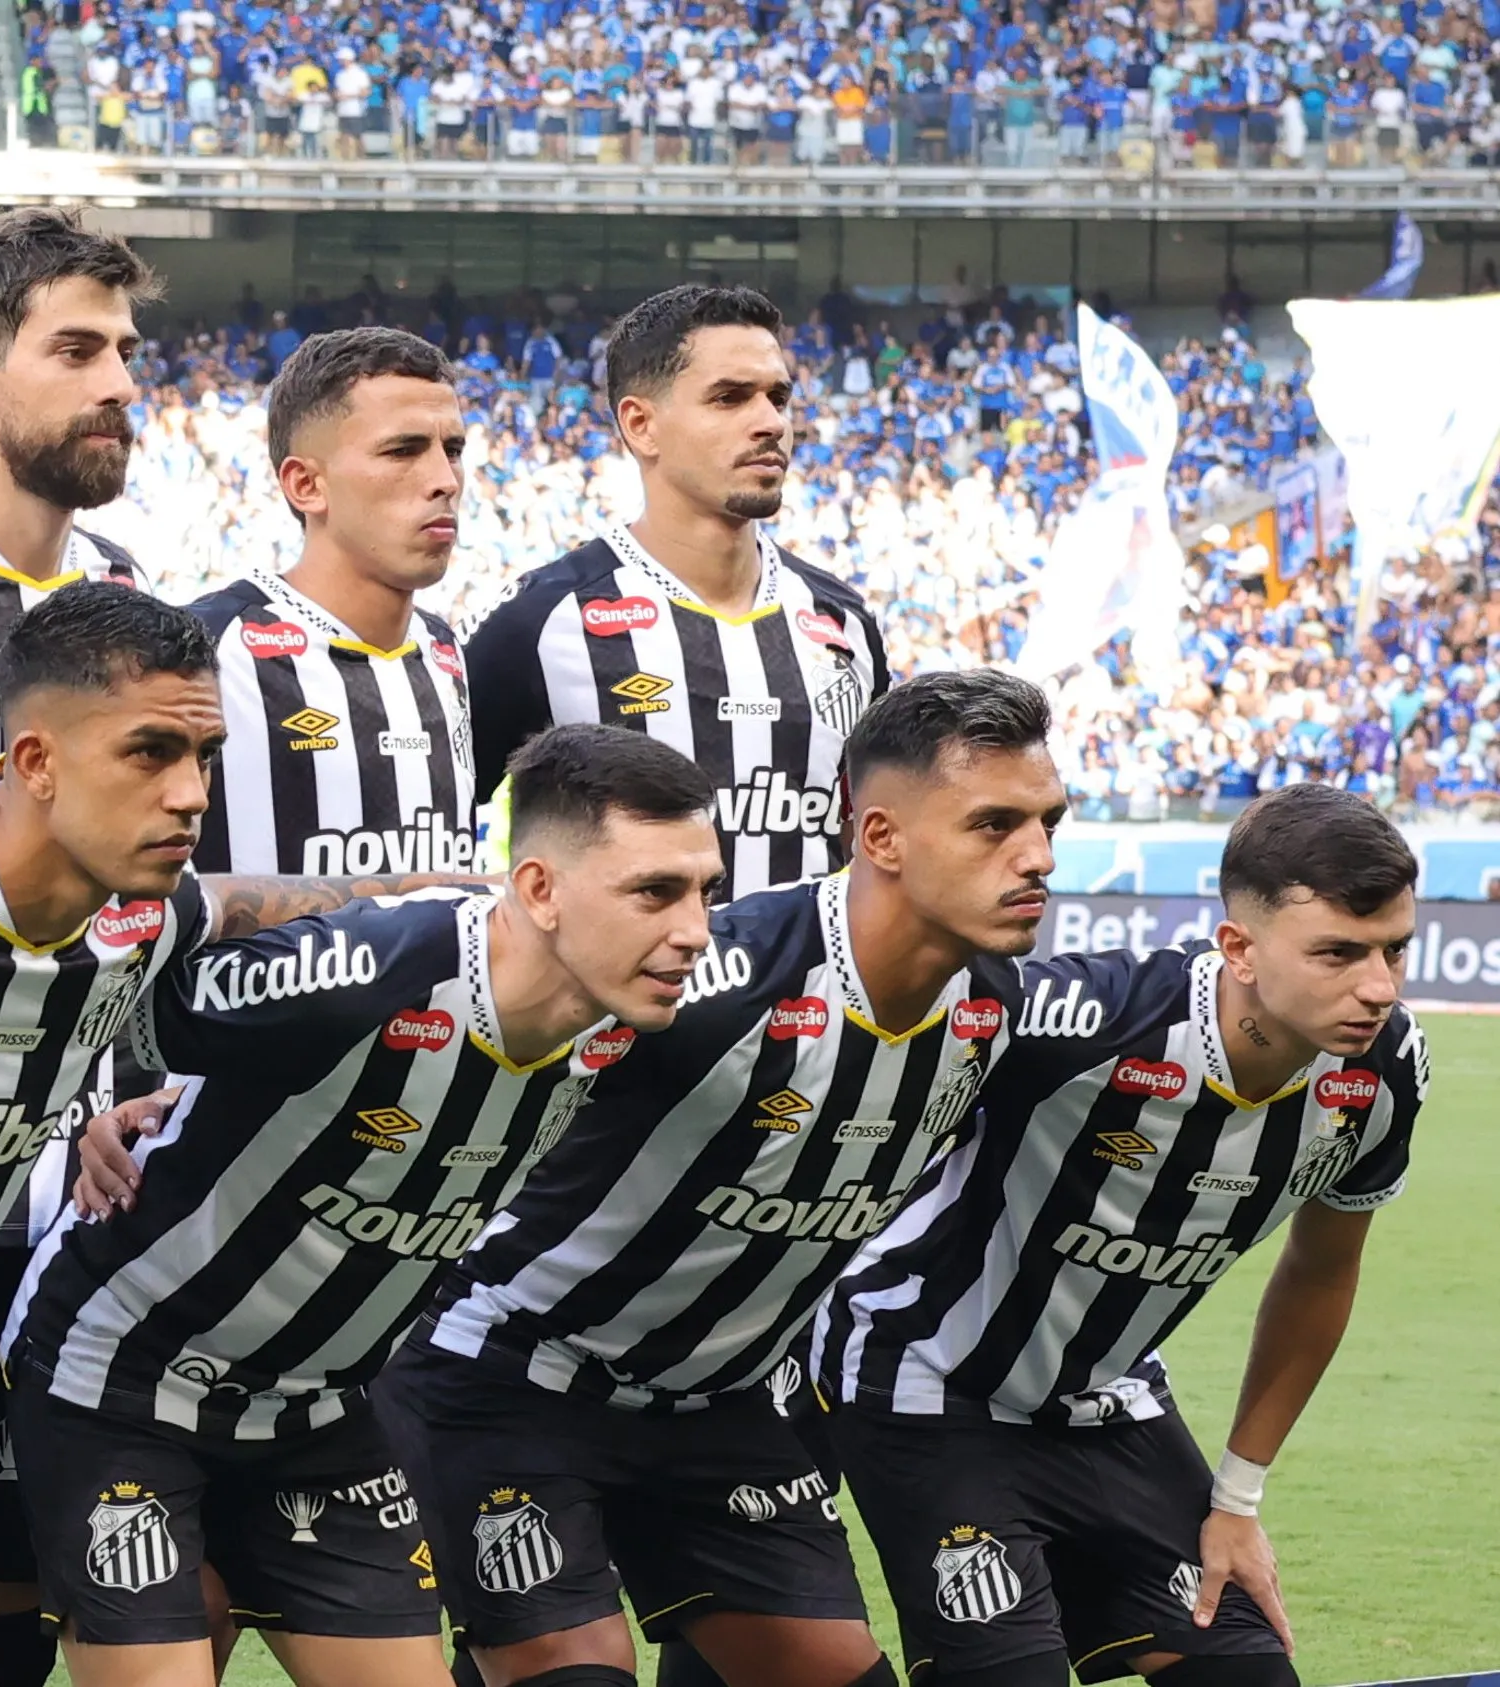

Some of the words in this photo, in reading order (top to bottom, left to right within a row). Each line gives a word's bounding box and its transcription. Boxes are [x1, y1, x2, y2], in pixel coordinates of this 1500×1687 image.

[585, 603, 656, 626] Canção
[243, 629, 305, 650] Canção
[619, 699, 670, 715] umbro
[290, 736, 338, 751] umbro
[96, 906, 162, 937] Canção
[1052, 901, 1156, 956] Bet
[192, 930, 378, 1012] Kicaldo
[771, 1003, 828, 1031] Canção
[954, 1003, 999, 1032] Canção
[388, 1016, 451, 1044] Canção
[1116, 1065, 1183, 1091] Canção
[752, 1118, 801, 1134] umbro
[352, 1129, 406, 1152] umbro
[1092, 1147, 1141, 1169] umbro
